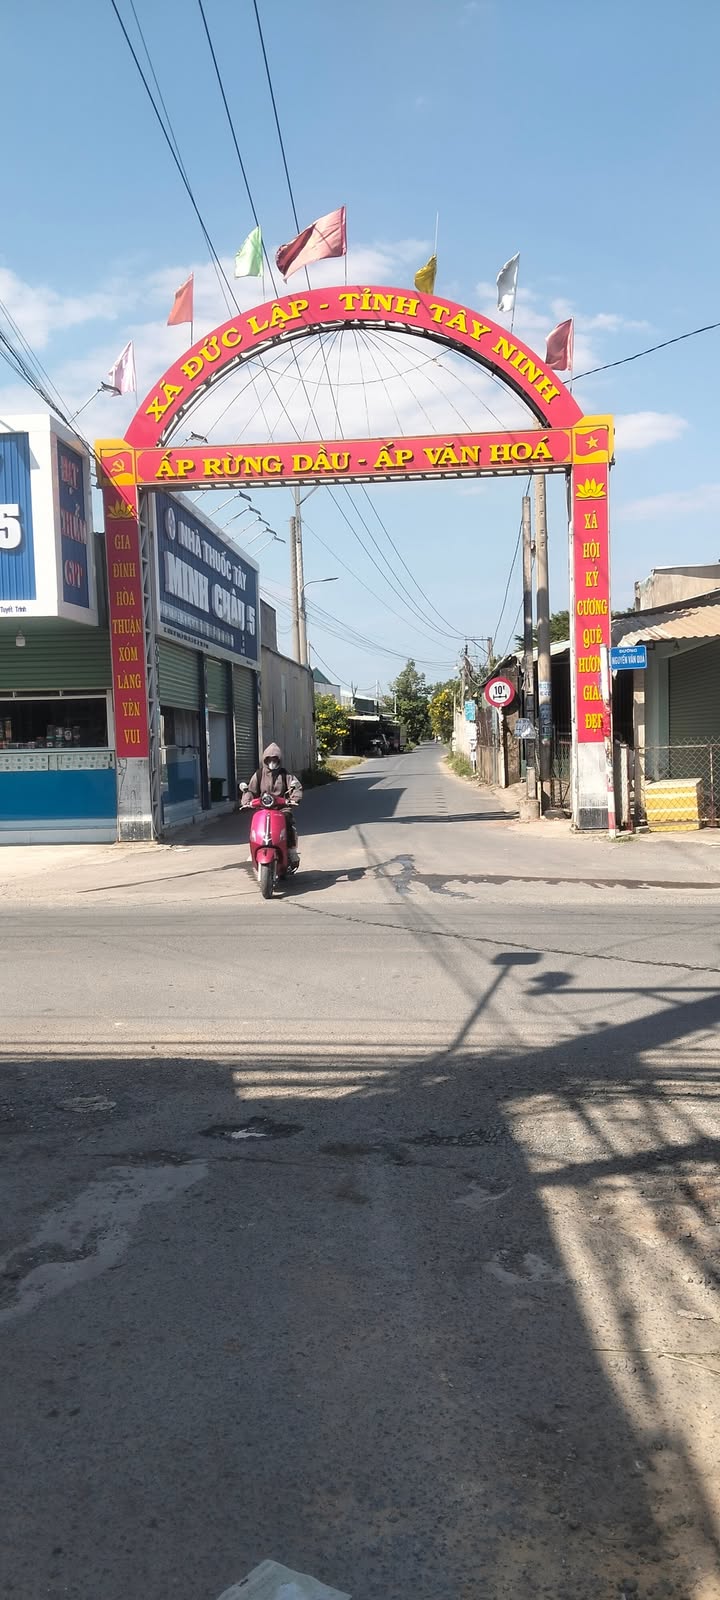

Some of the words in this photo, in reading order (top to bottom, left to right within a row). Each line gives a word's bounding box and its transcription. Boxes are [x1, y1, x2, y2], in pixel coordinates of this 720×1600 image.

[145, 379, 184, 423] XÃ
[181, 326, 243, 381] ĐỨC
[246, 298, 310, 335] LẬP
[338, 287, 421, 317] TỈNH
[430, 303, 492, 341] TÂY
[491, 336, 561, 405] NINH
[155, 451, 195, 478] ẤP
[203, 451, 283, 476] RỪNG
[292, 443, 350, 474] DẦU
[374, 441, 414, 469] ẤP
[423, 442, 481, 467] VĂN
[489, 435, 554, 464] HOÁ
[114, 534, 131, 550] GIA
[582, 538, 601, 562] HỘI
[177, 519, 202, 559] NHÀ
[201, 539, 232, 580] THUỐC
[232, 565, 247, 591] TÂY
[112, 559, 136, 578] ĐÌNH
[116, 587, 136, 606] HÒA
[163, 550, 209, 613] MINH
[211, 583, 245, 632] CHÂU
[246, 604, 256, 636] 5
[576, 598, 608, 616] CƯƠNG
[112, 615, 142, 637] THUẬN
[583, 624, 603, 649] QUÊ
[118, 641, 139, 662] XÓM
[117, 670, 142, 689] LÀNG
[122, 698, 141, 717] YÊN
[123, 729, 141, 744] VUI
